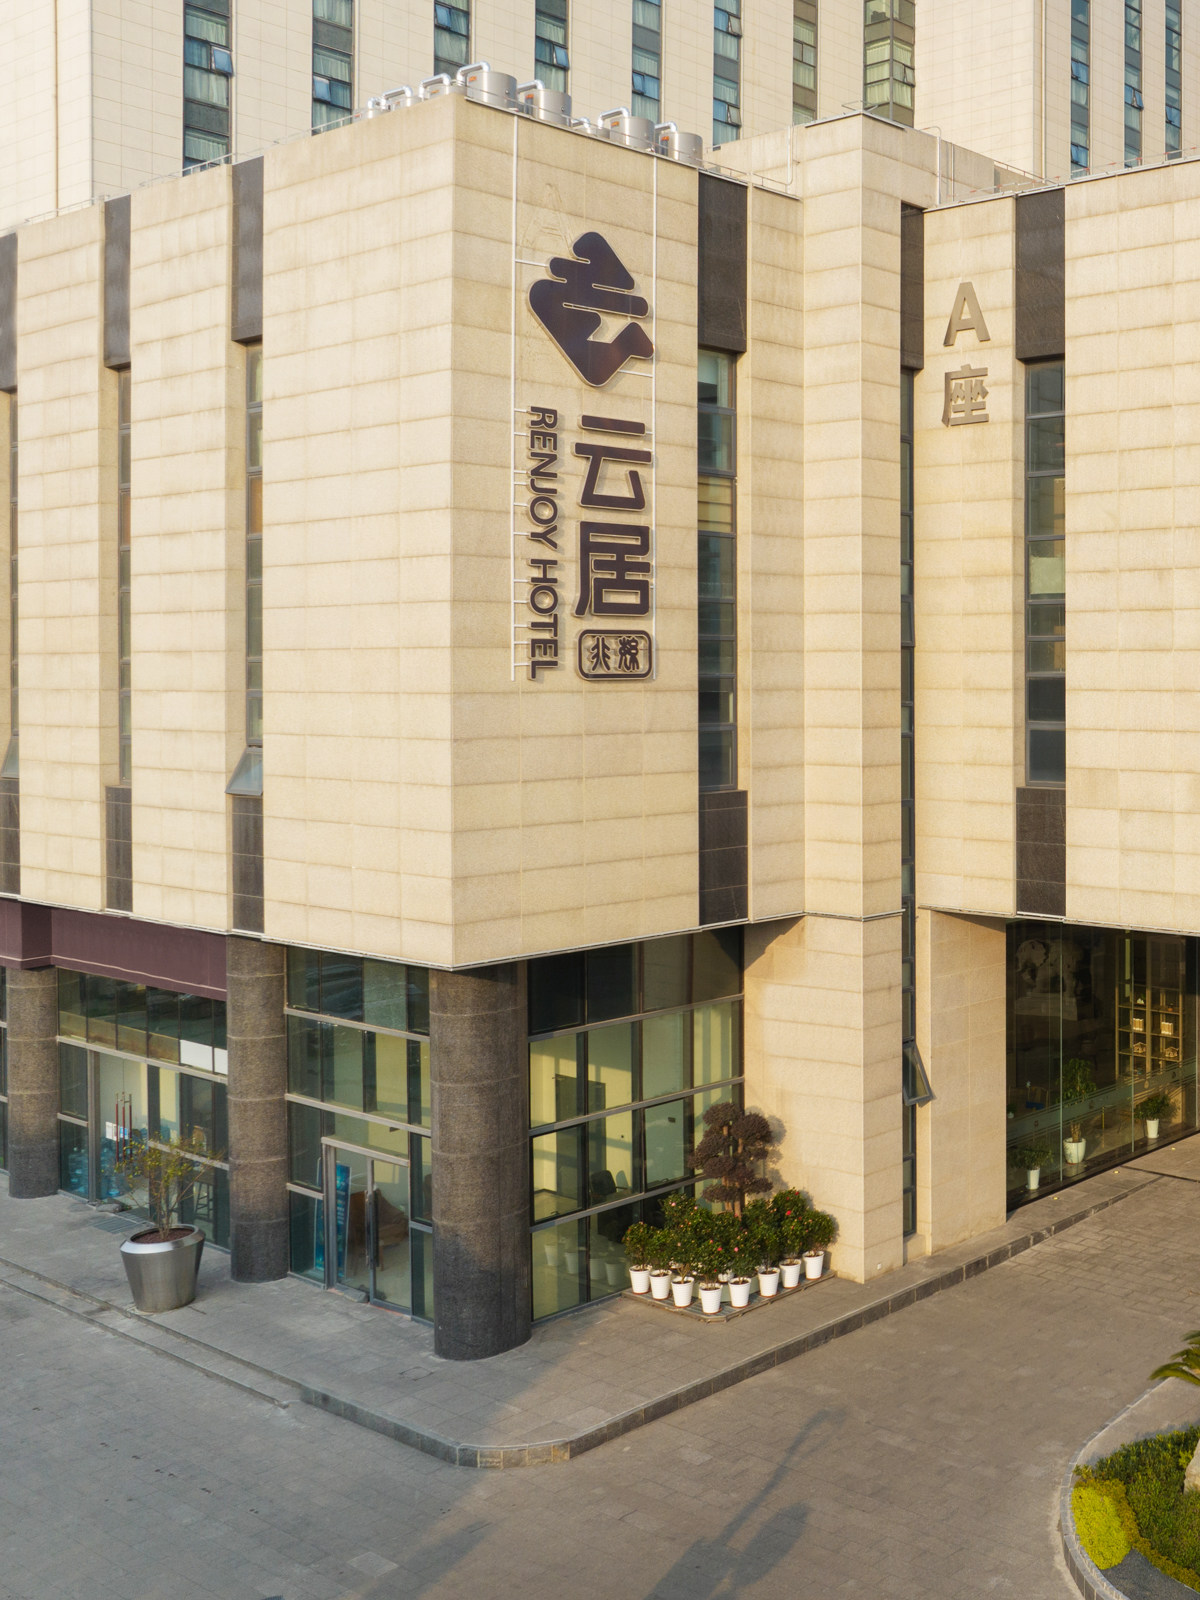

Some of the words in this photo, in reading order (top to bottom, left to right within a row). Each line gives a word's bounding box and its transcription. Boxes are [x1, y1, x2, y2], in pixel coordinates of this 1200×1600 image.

[942, 281, 990, 428] A座
[529, 405, 558, 550] RENJOY
[574, 414, 652, 616] 云居
[529, 558, 558, 680] HOTEL
